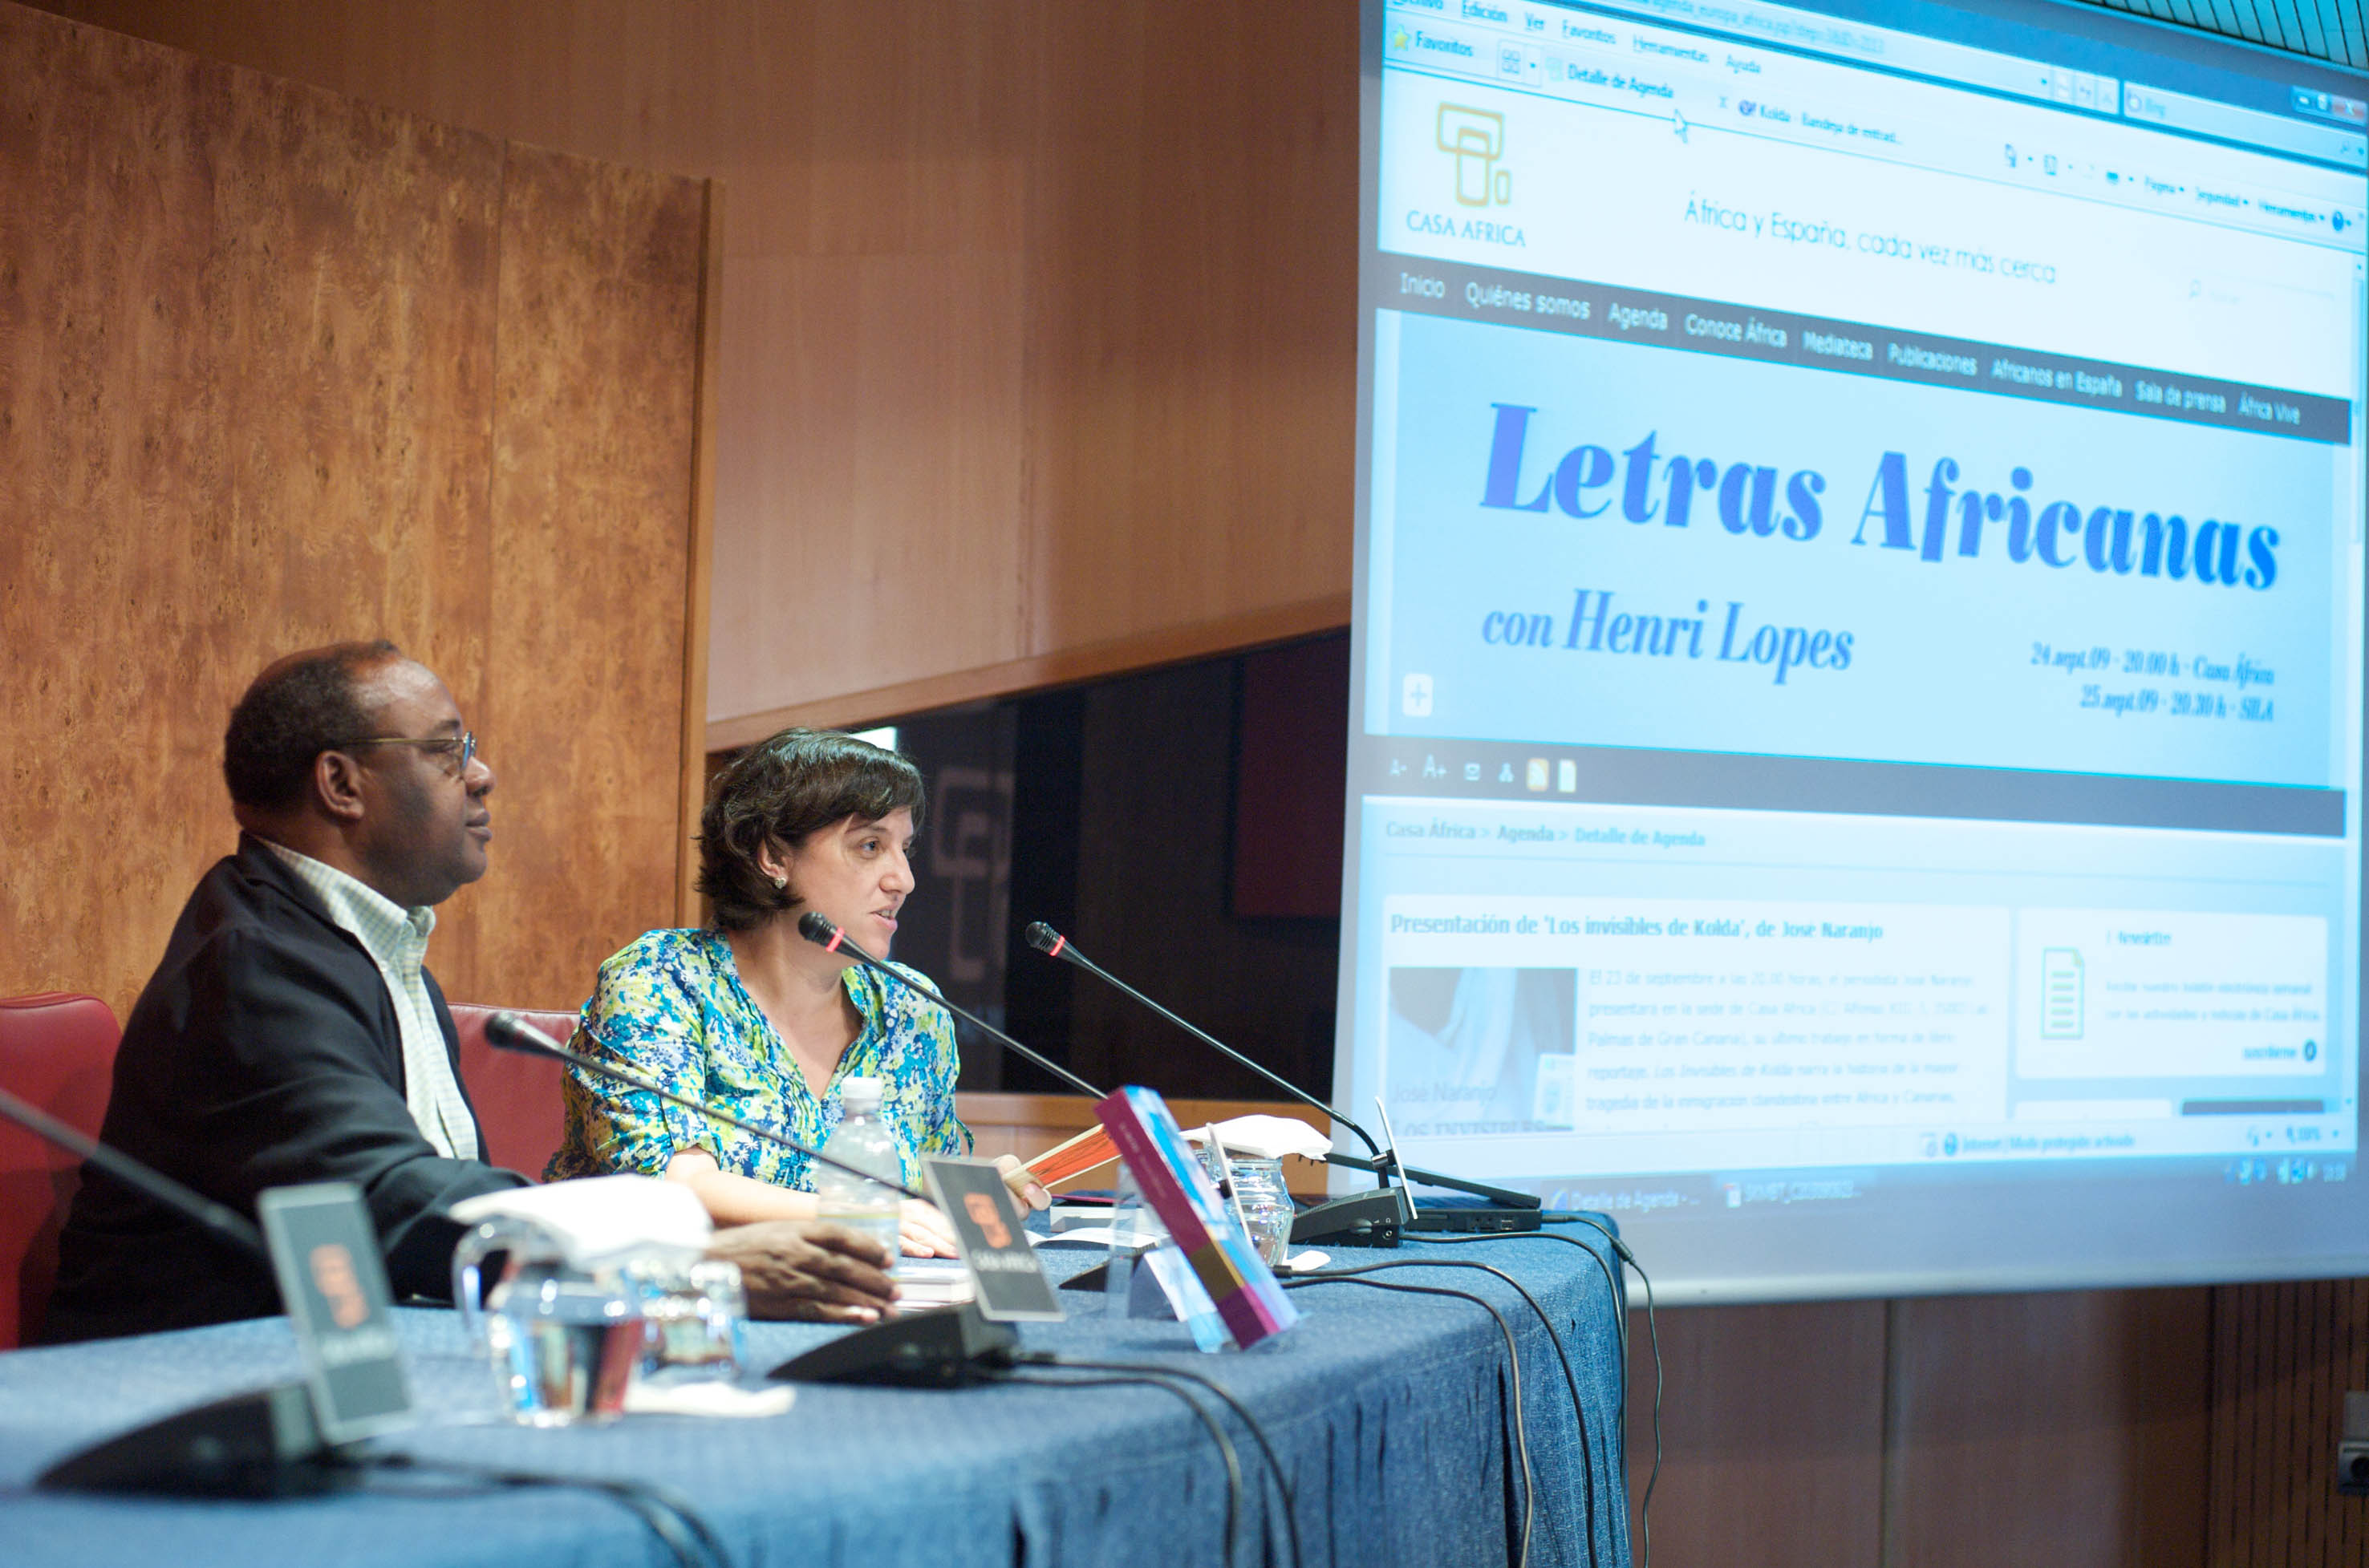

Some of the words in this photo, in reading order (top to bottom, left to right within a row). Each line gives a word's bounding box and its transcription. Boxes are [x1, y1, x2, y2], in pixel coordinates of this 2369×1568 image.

[1415, 30, 1475, 57] Favoritos
[1525, 11, 1545, 30] Ver
[1726, 55, 1761, 74] Ayuda
[1568, 63, 1608, 85] Detalle
[1612, 72, 1626, 89] de
[1629, 76, 1674, 99] Agenda
[1406, 209, 1456, 237] CASA
[1684, 190, 1746, 232] África
[1754, 214, 1765, 239] y
[1857, 230, 1913, 260] cada
[1919, 242, 1951, 266] vez
[1956, 245, 1995, 273] más
[2000, 257, 2057, 284] cerca
[1400, 273, 1446, 299] Inicio
[1465, 282, 1532, 310] Quiénes
[1535, 294, 1591, 320] somos
[1608, 302, 1668, 331] Agenda
[1685, 313, 1742, 342] Conoce
[1745, 315, 1788, 349] África
[1803, 330, 1874, 361] Mediateca
[1887, 342, 1978, 377] Publicaciones
[1991, 359, 2054, 388] Africanos
[2055, 371, 2074, 390] en
[2075, 370, 2124, 398] España
[2135, 379, 2163, 404] Sala
[2166, 385, 2181, 407] de
[2182, 391, 2227, 415] prensa
[2237, 392, 2273, 421] África
[2274, 401, 2301, 426] Vive
[1479, 402, 1827, 542] Letras
[1850, 449, 2281, 591] Africanas
[1481, 608, 1554, 649] con
[1562, 588, 1706, 660] Henri
[1715, 601, 1856, 686] Lopes
[2122, 648, 2168, 676] 20.00
[2169, 651, 2180, 678] h
[2193, 654, 2230, 682] Casa
[2234, 650, 2275, 691] África
[2170, 691, 2213, 718] 20.30
[2216, 695, 2227, 719] h
[1385, 822, 1424, 838] Casa
[1429, 816, 1476, 840] África
[1497, 825, 1555, 845] Agenda
[1575, 827, 1627, 845] Detalle
[1630, 829, 1649, 845] de
[1653, 830, 1706, 849] Agenda
[1391, 913, 1510, 934] Presentación
[1515, 915, 1537, 935] de
[1585, 916, 1663, 937] invisibles
[1668, 918, 1689, 937] de
[1755, 919, 1776, 938] de
[1781, 921, 1816, 938] José
[1820, 922, 1883, 943] Naranjo
